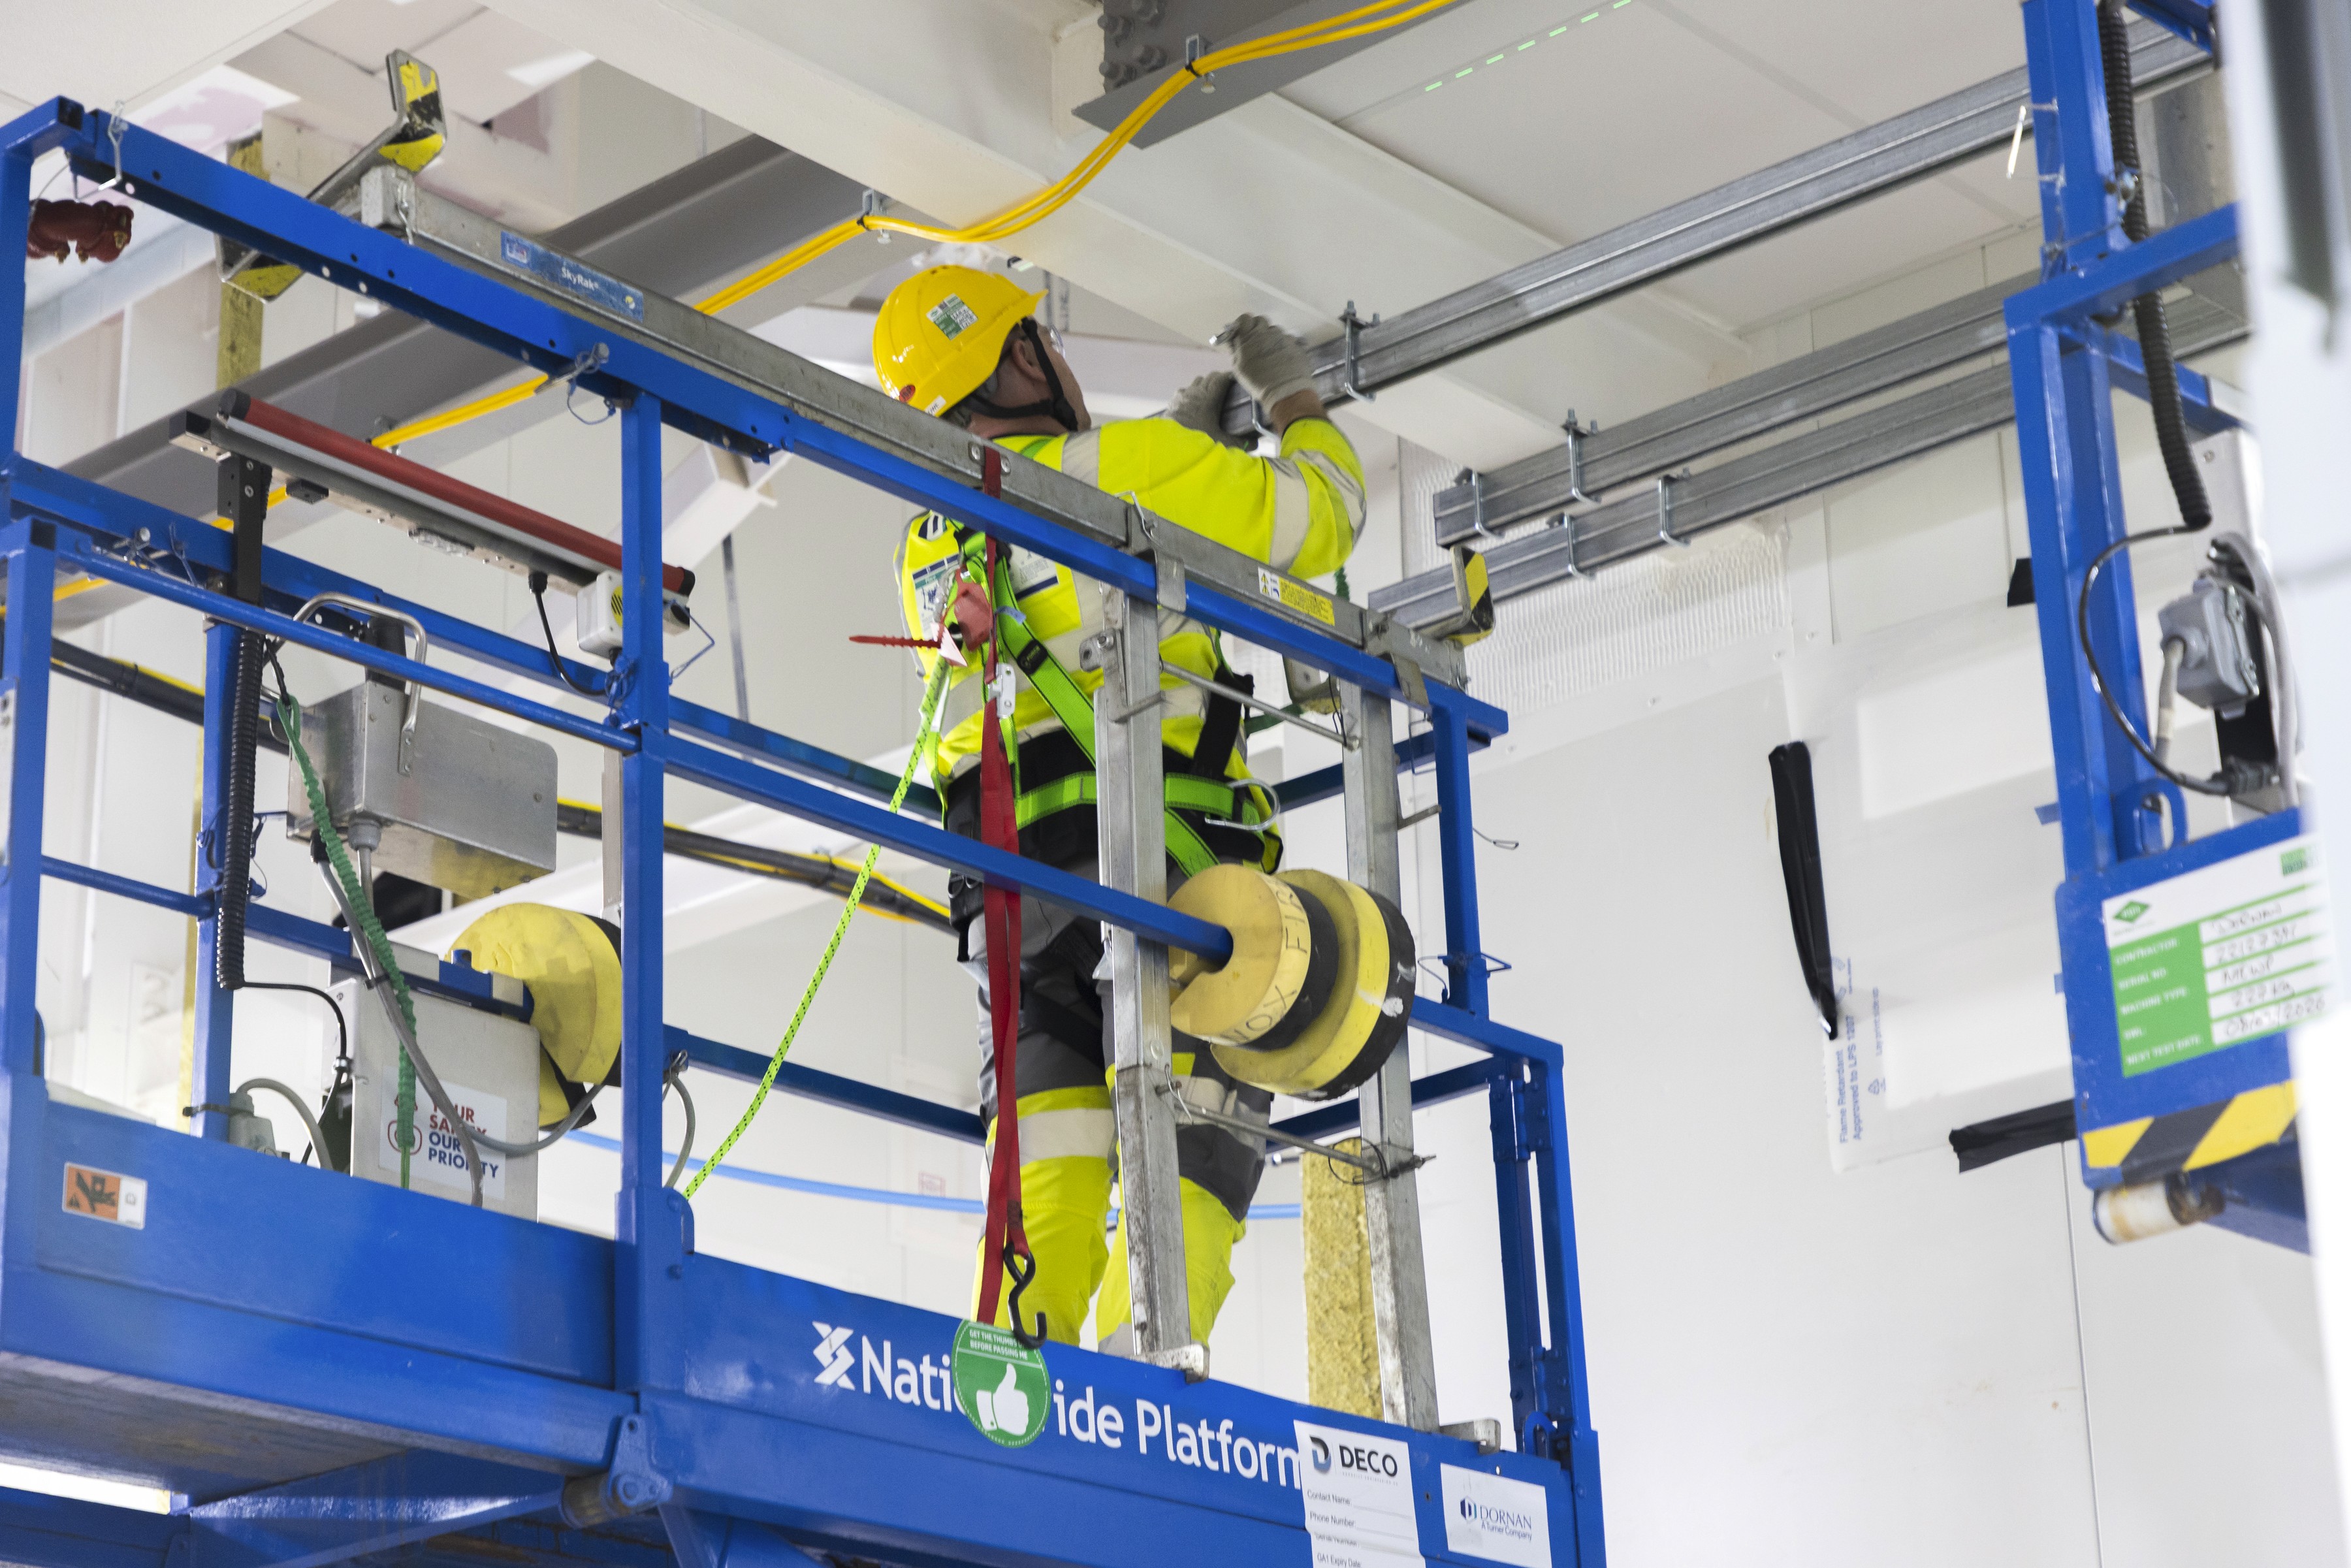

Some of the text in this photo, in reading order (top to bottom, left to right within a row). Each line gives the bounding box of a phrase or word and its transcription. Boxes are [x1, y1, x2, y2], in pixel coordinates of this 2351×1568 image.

[1836, 1049, 1849, 1144] Flame Retardant
[1850, 1084, 1863, 1140] Approved
[428, 1132, 461, 1153] OUR
[428, 1147, 499, 1179] PRIOTY
[969, 1329, 980, 1339] GET
[981, 1331, 993, 1342] THE
[993, 1334, 1017, 1347] THUMBS
[970, 1339, 1028, 1360] BEFORE PASSING ME
[1339, 1443, 1398, 1478] DECO
[1307, 1489, 1331, 1502] Contact
[1309, 1511, 1330, 1523] Phone
[1479, 1505, 1532, 1529] DORNAN
[1481, 1520, 1533, 1543] A Turner Company
[1330, 1554, 1347, 1568] Expiry
